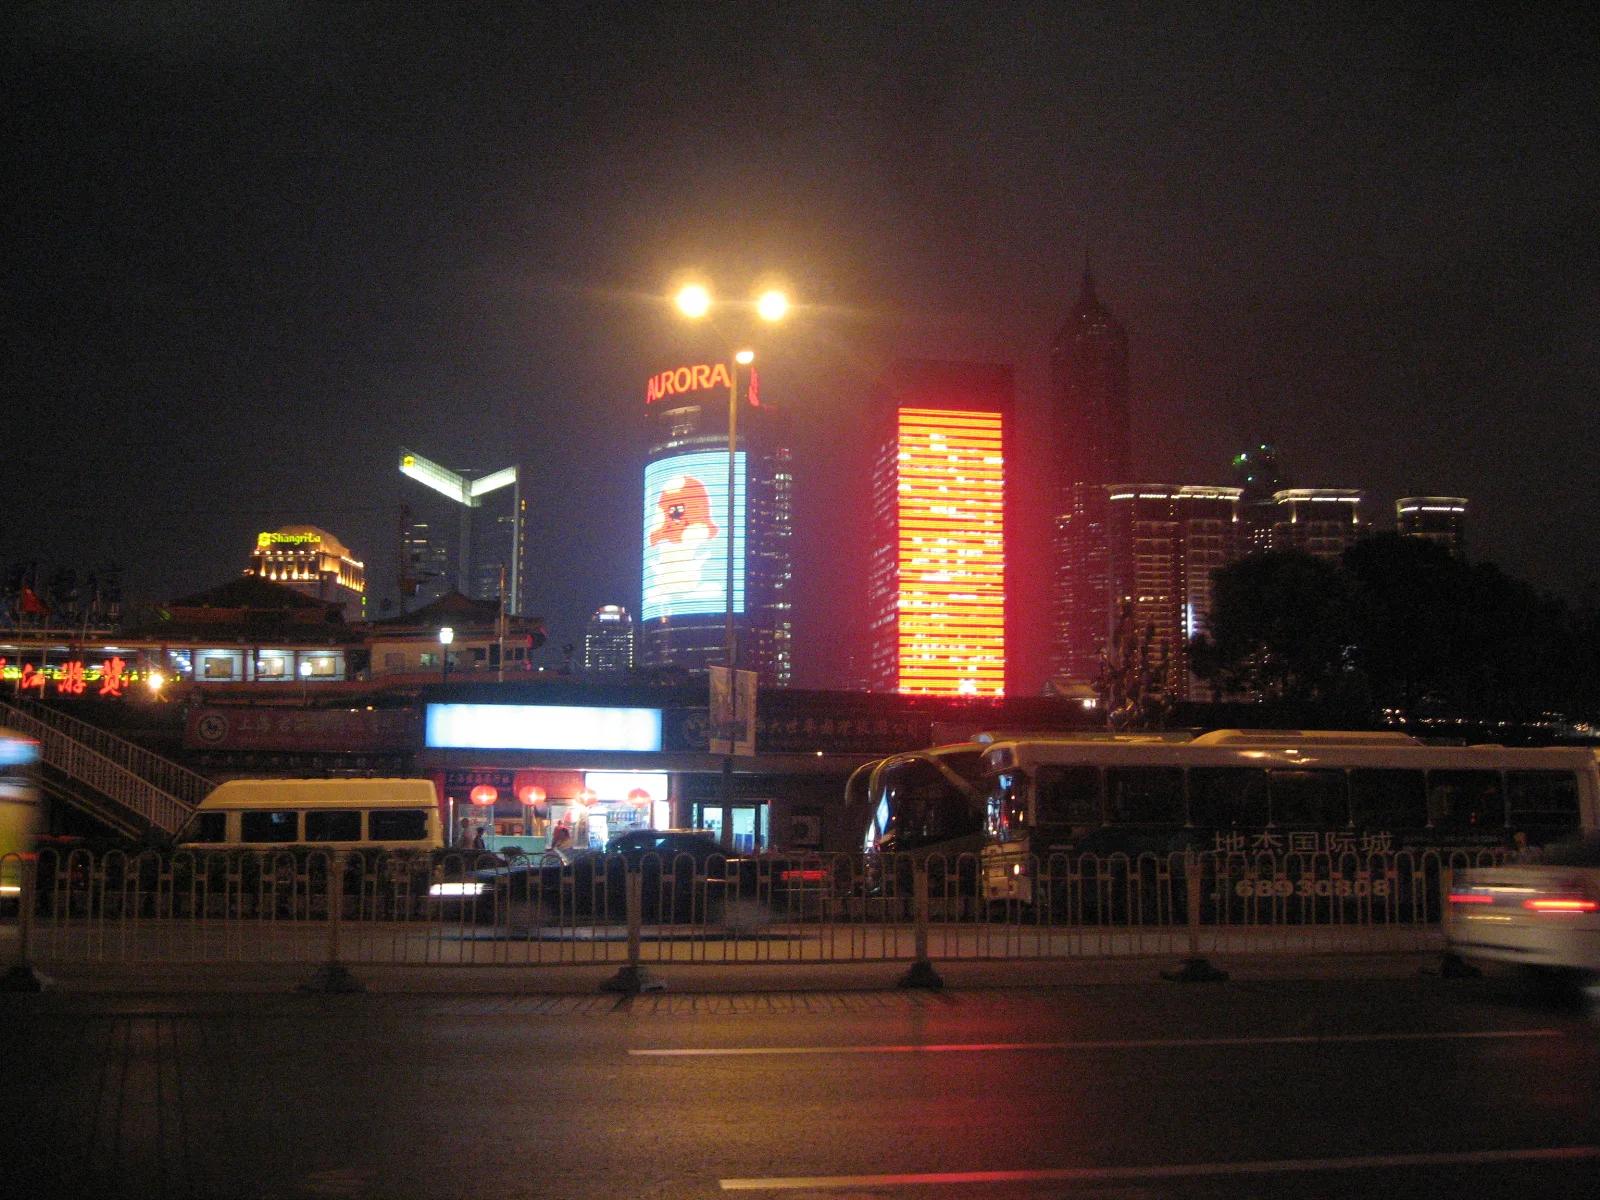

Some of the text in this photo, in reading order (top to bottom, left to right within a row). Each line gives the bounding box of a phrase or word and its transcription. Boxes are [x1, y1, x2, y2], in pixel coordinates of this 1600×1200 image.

[647, 363, 732, 404] AURORA
[1213, 831, 1394, 855] 地杰国际城
[1235, 879, 1391, 897] 68930808
